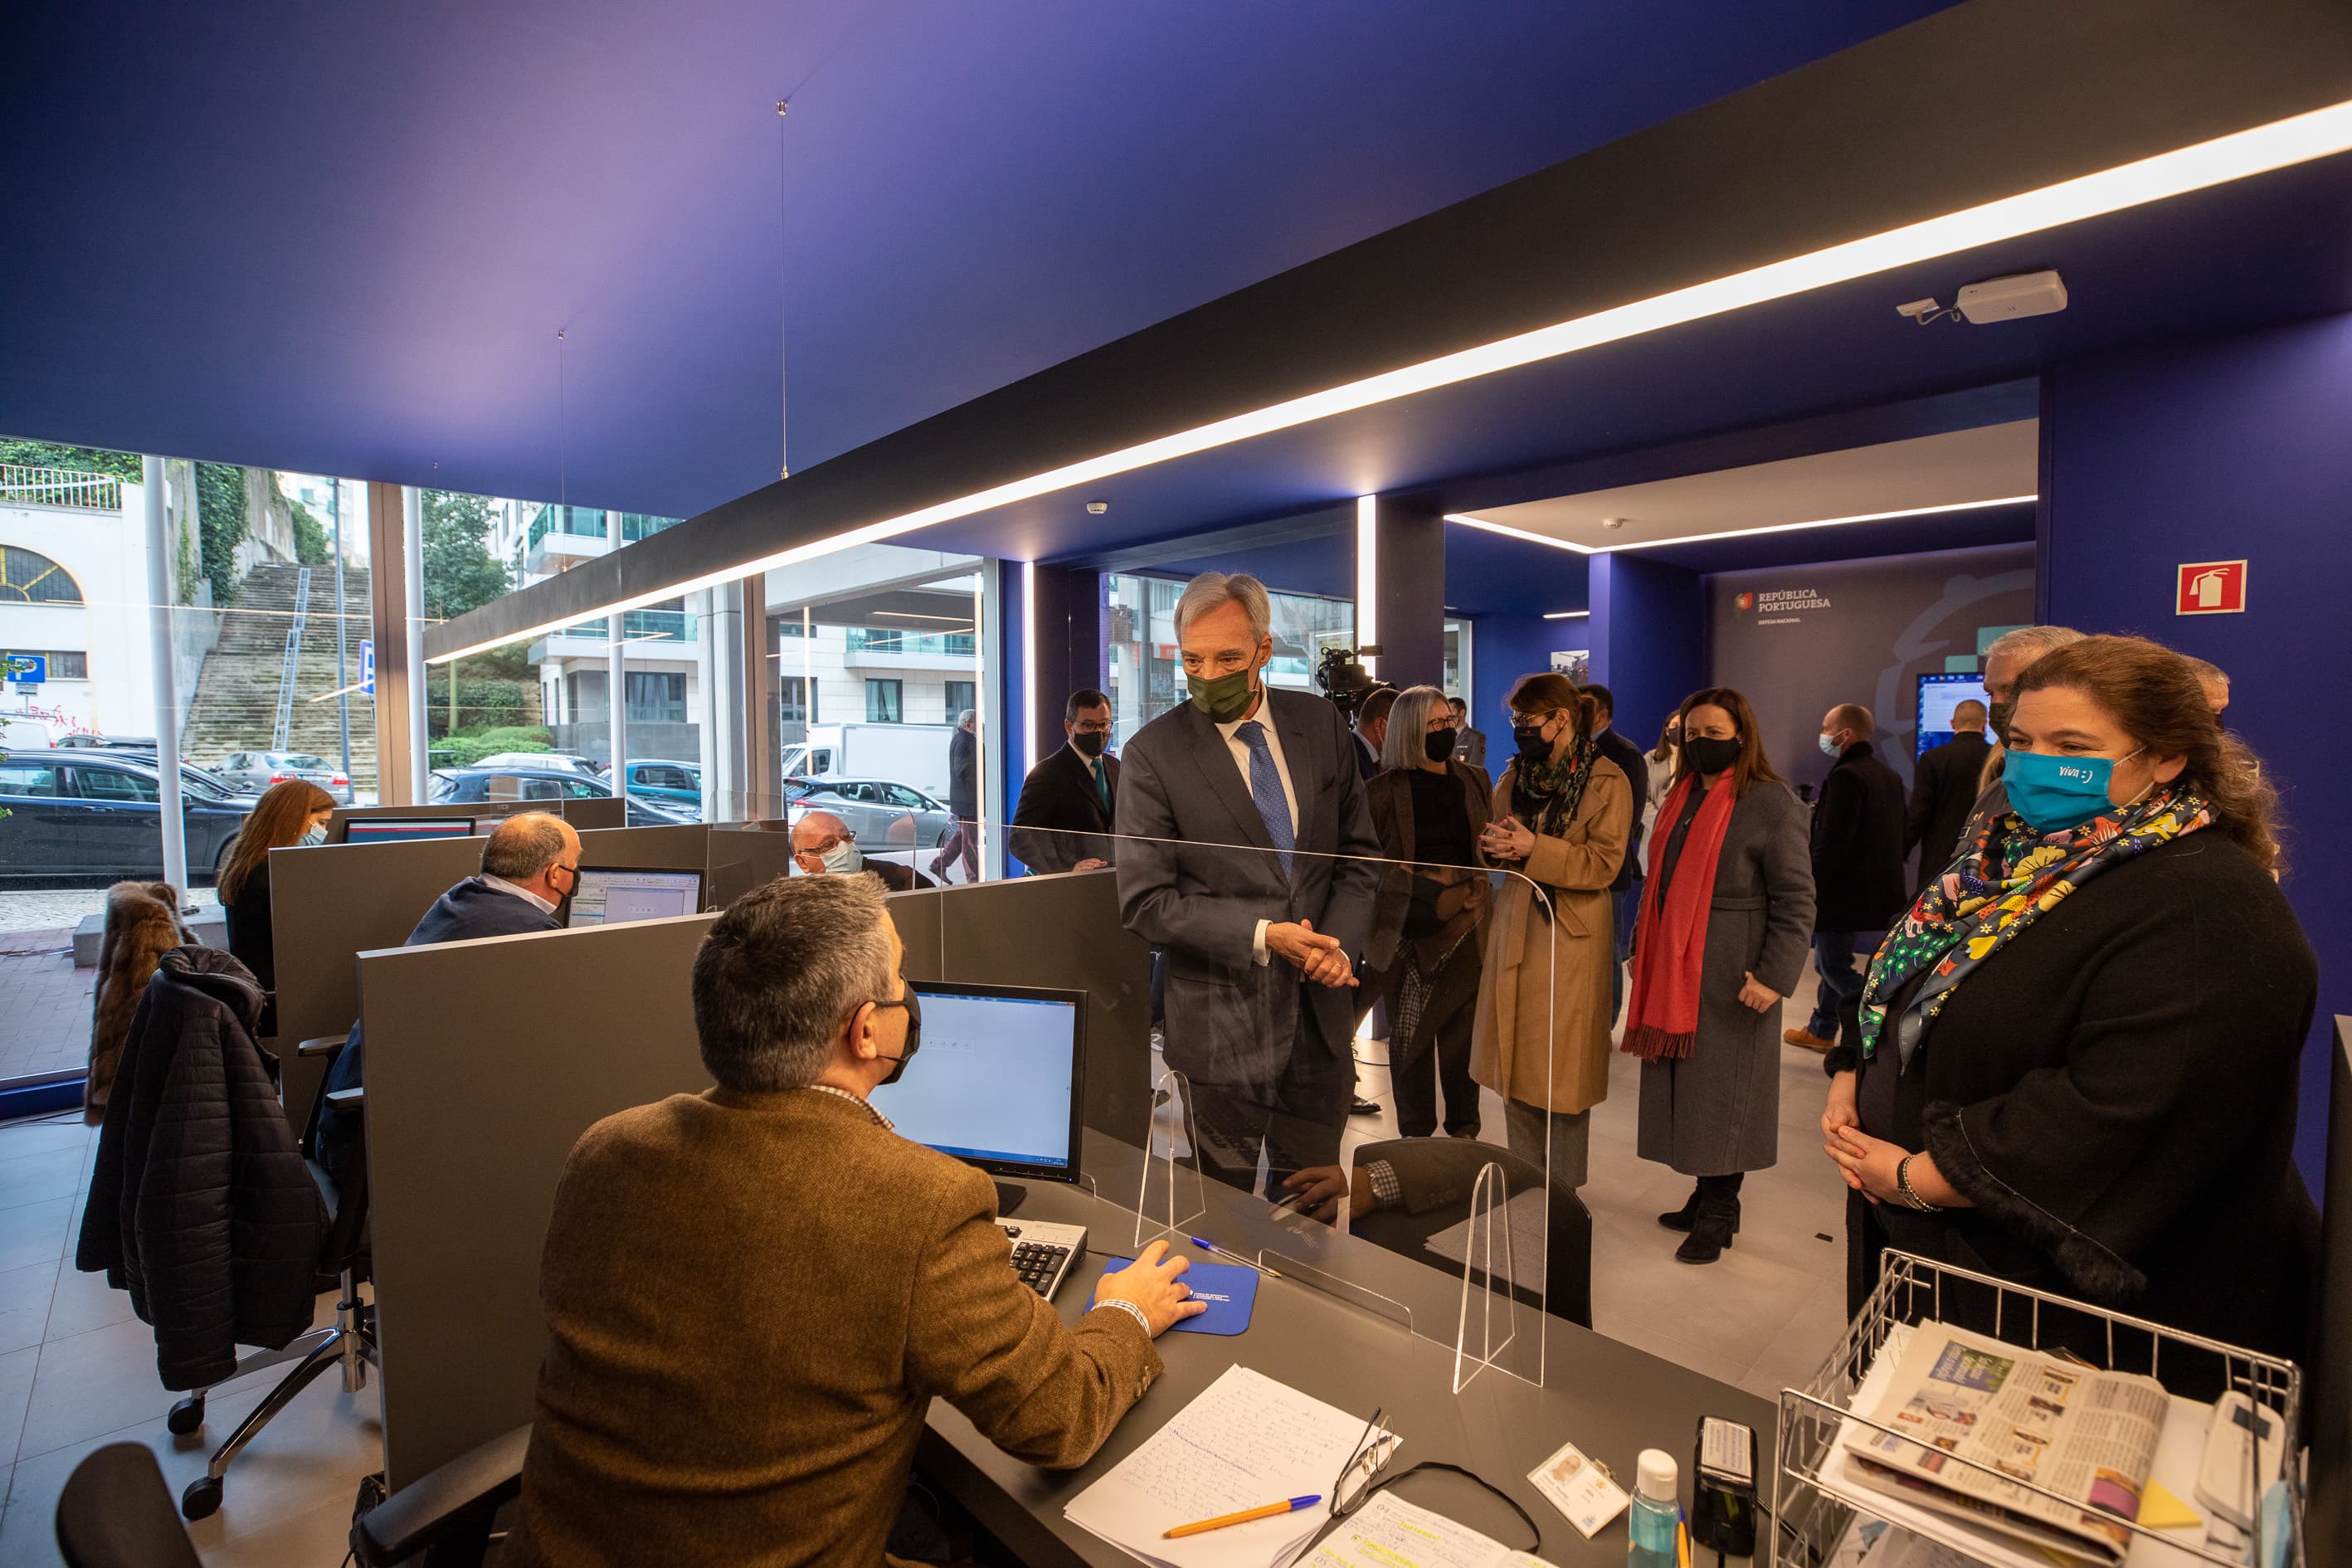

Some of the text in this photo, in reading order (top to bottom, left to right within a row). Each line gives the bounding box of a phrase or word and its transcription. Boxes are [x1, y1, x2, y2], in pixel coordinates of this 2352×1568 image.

[1759, 589, 1818, 602] REPÚBLICA
[1759, 598, 1831, 612] PORTUGUESA
[15, 657, 37, 680] P
[2059, 766, 2080, 778] Viva
